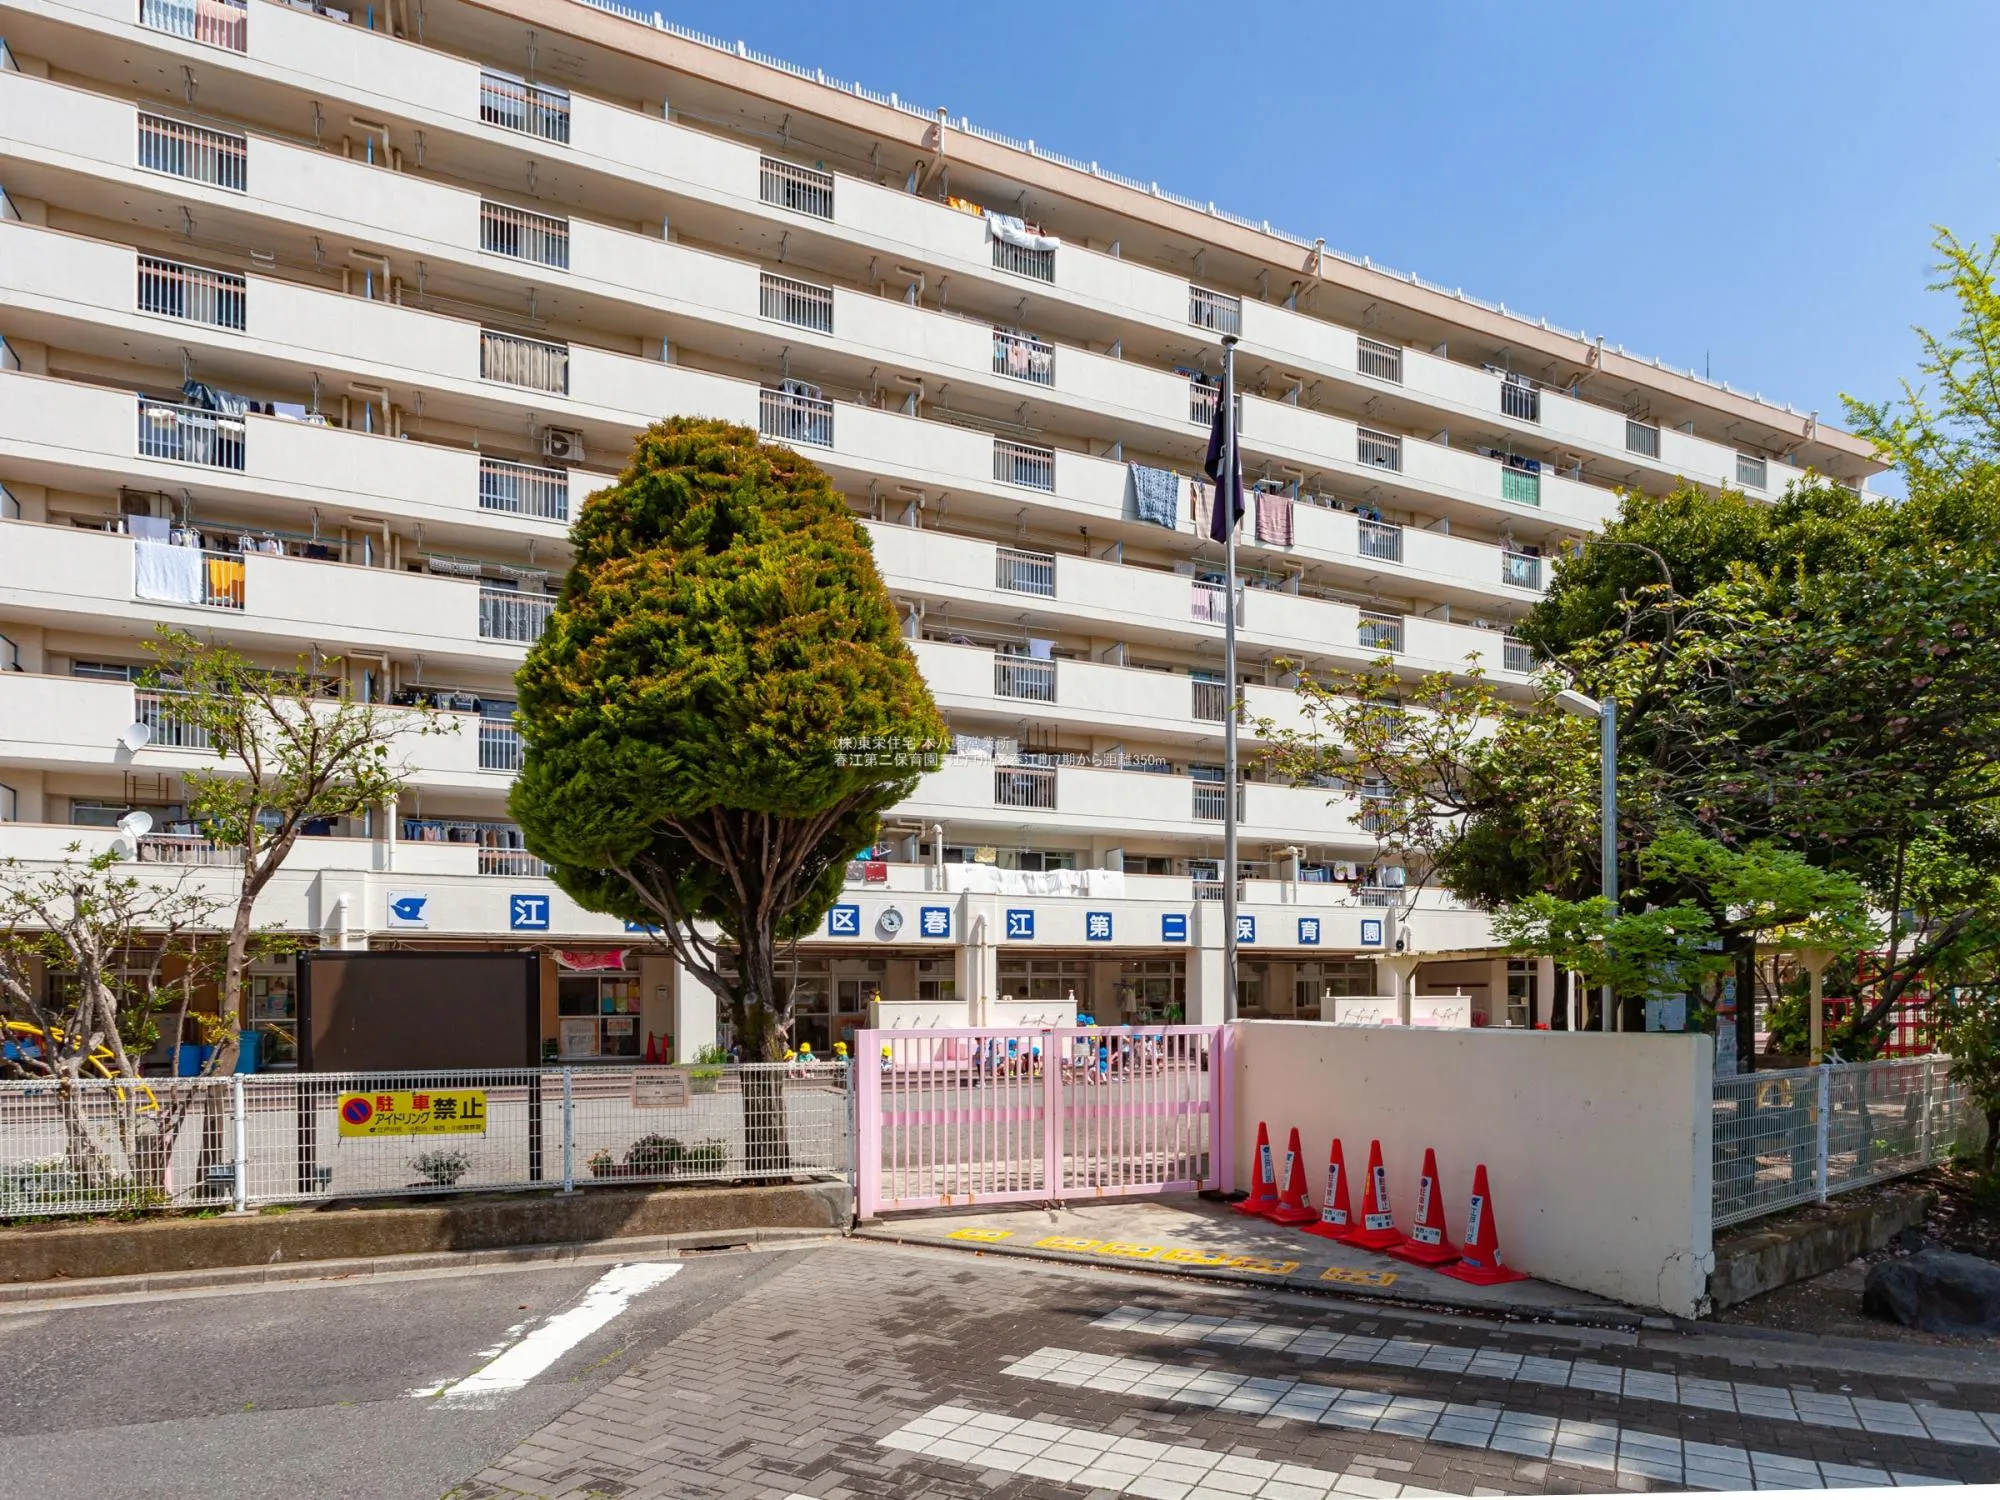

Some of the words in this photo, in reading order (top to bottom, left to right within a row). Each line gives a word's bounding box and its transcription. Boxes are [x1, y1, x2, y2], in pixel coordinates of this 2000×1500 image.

[375, 1095, 430, 1112] 駐車
[433, 1097, 484, 1120] 禁止
[375, 1111, 431, 1125] アイドリング
